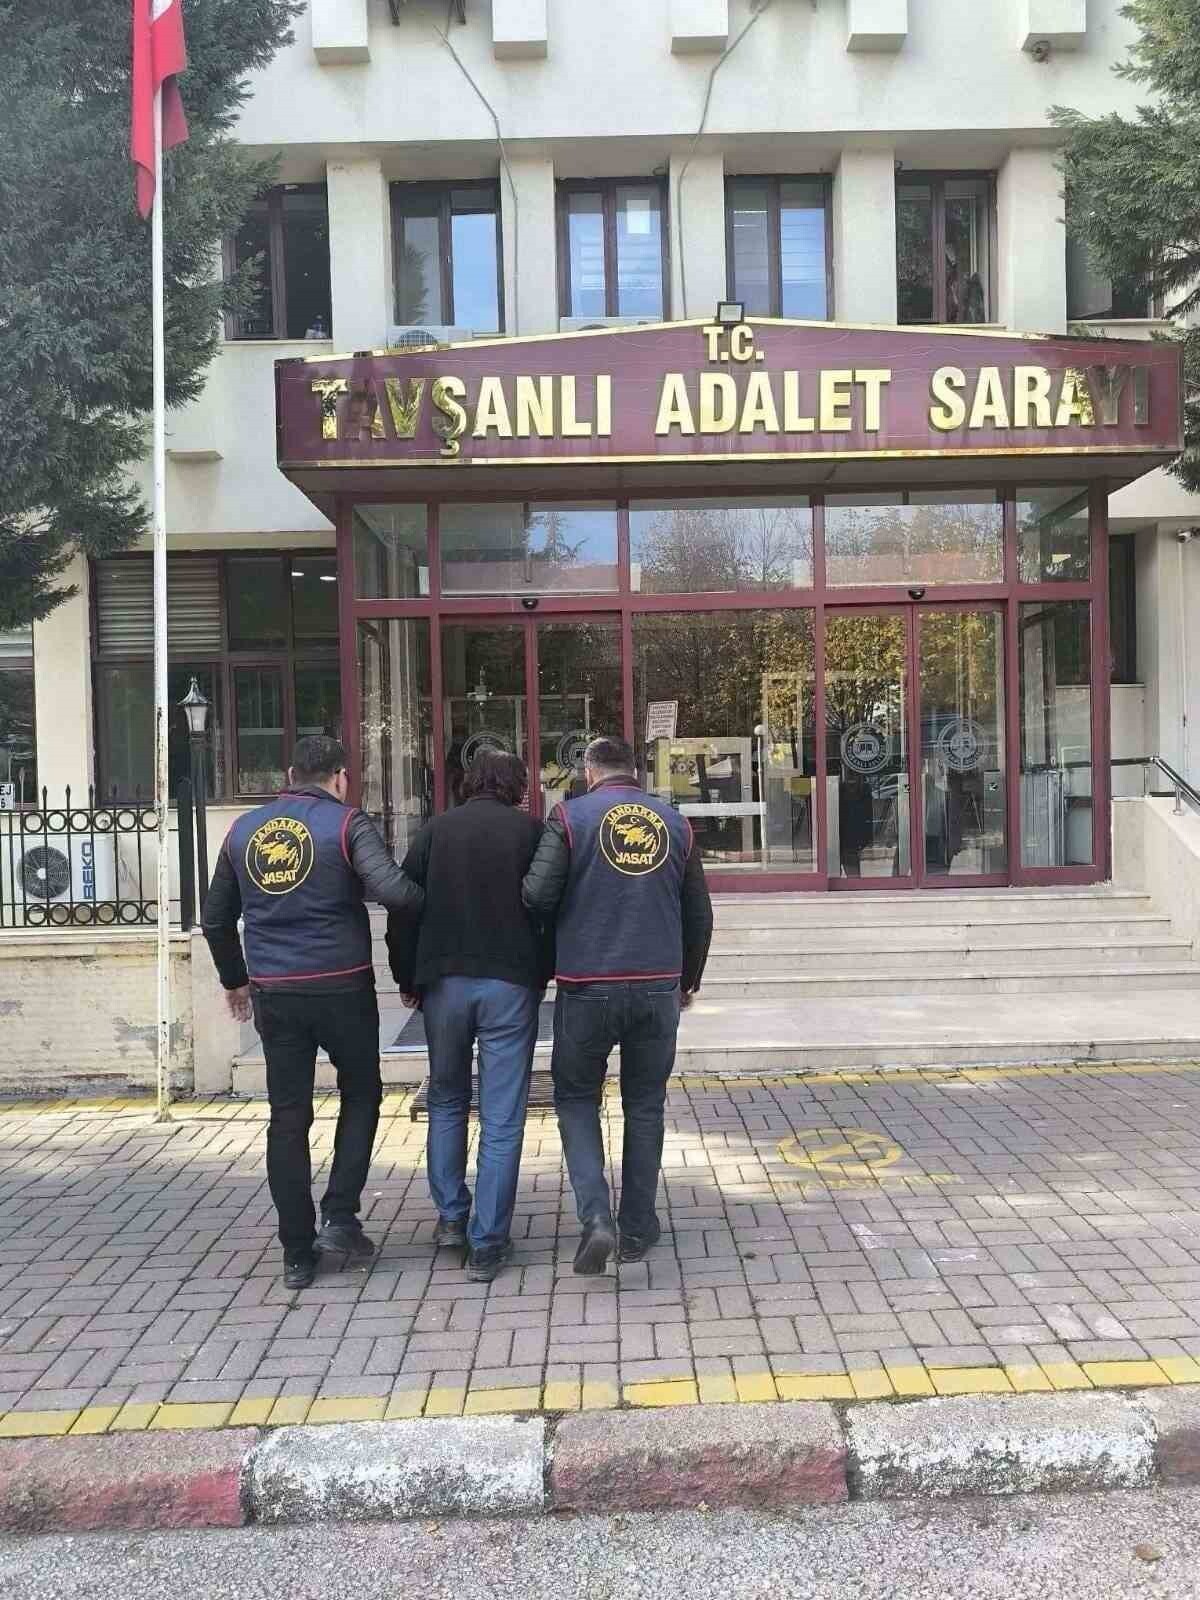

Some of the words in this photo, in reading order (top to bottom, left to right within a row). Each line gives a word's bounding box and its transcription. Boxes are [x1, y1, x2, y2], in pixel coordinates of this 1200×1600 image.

[703, 325, 765, 362] T.C.
[311, 373, 613, 457] TAVŞANLI
[655, 368, 892, 437] ADALET
[929, 365, 1151, 431] SARAYI
[606, 805, 664, 830] JANDARMA
[254, 820, 309, 847] JANDARMA
[81, 841, 94, 900] BEKO
[615, 852, 655, 865] JASAT
[262, 869, 298, 885] JASAT
